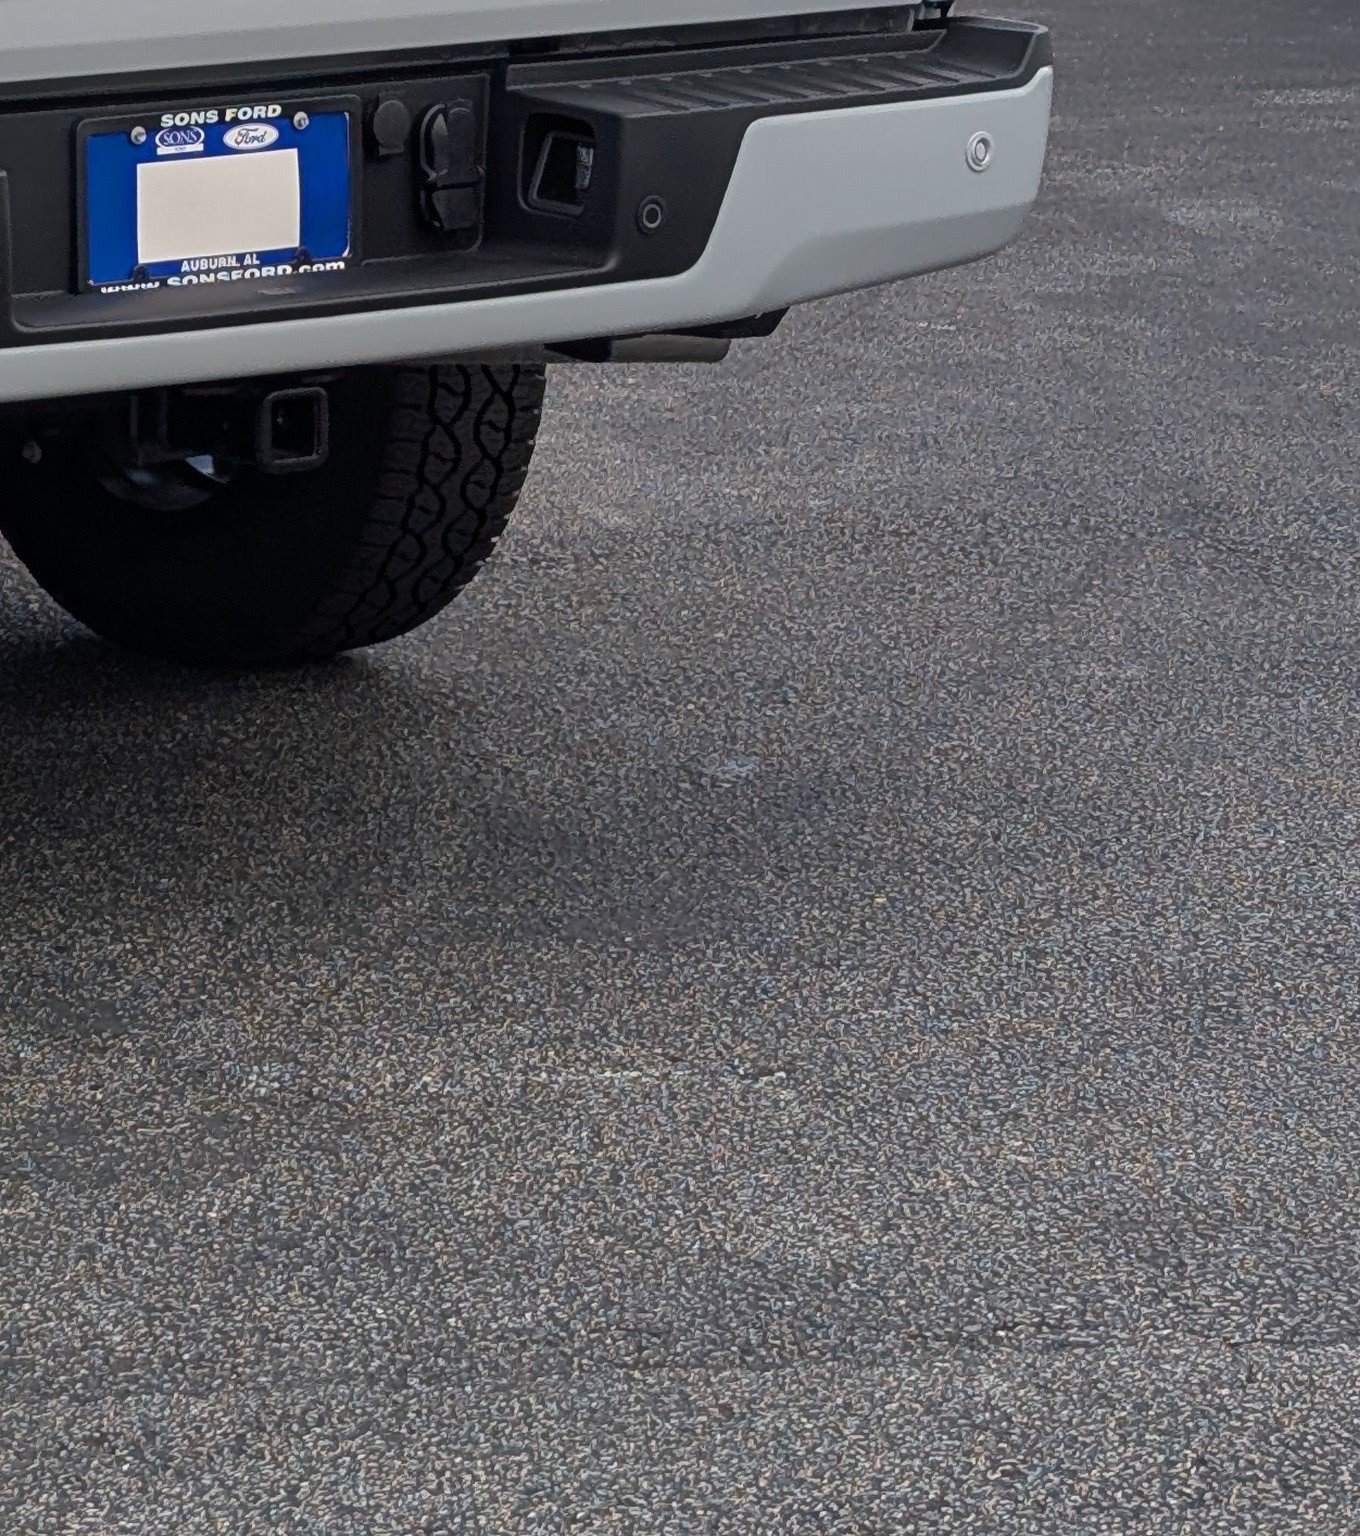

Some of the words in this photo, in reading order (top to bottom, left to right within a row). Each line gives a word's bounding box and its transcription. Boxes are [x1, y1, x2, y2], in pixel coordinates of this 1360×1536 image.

[160, 110, 219, 128] SONS
[225, 104, 282, 122] FORD
[162, 128, 199, 145] SONS
[234, 127, 268, 147] Ford
[243, 253, 261, 266] AL
